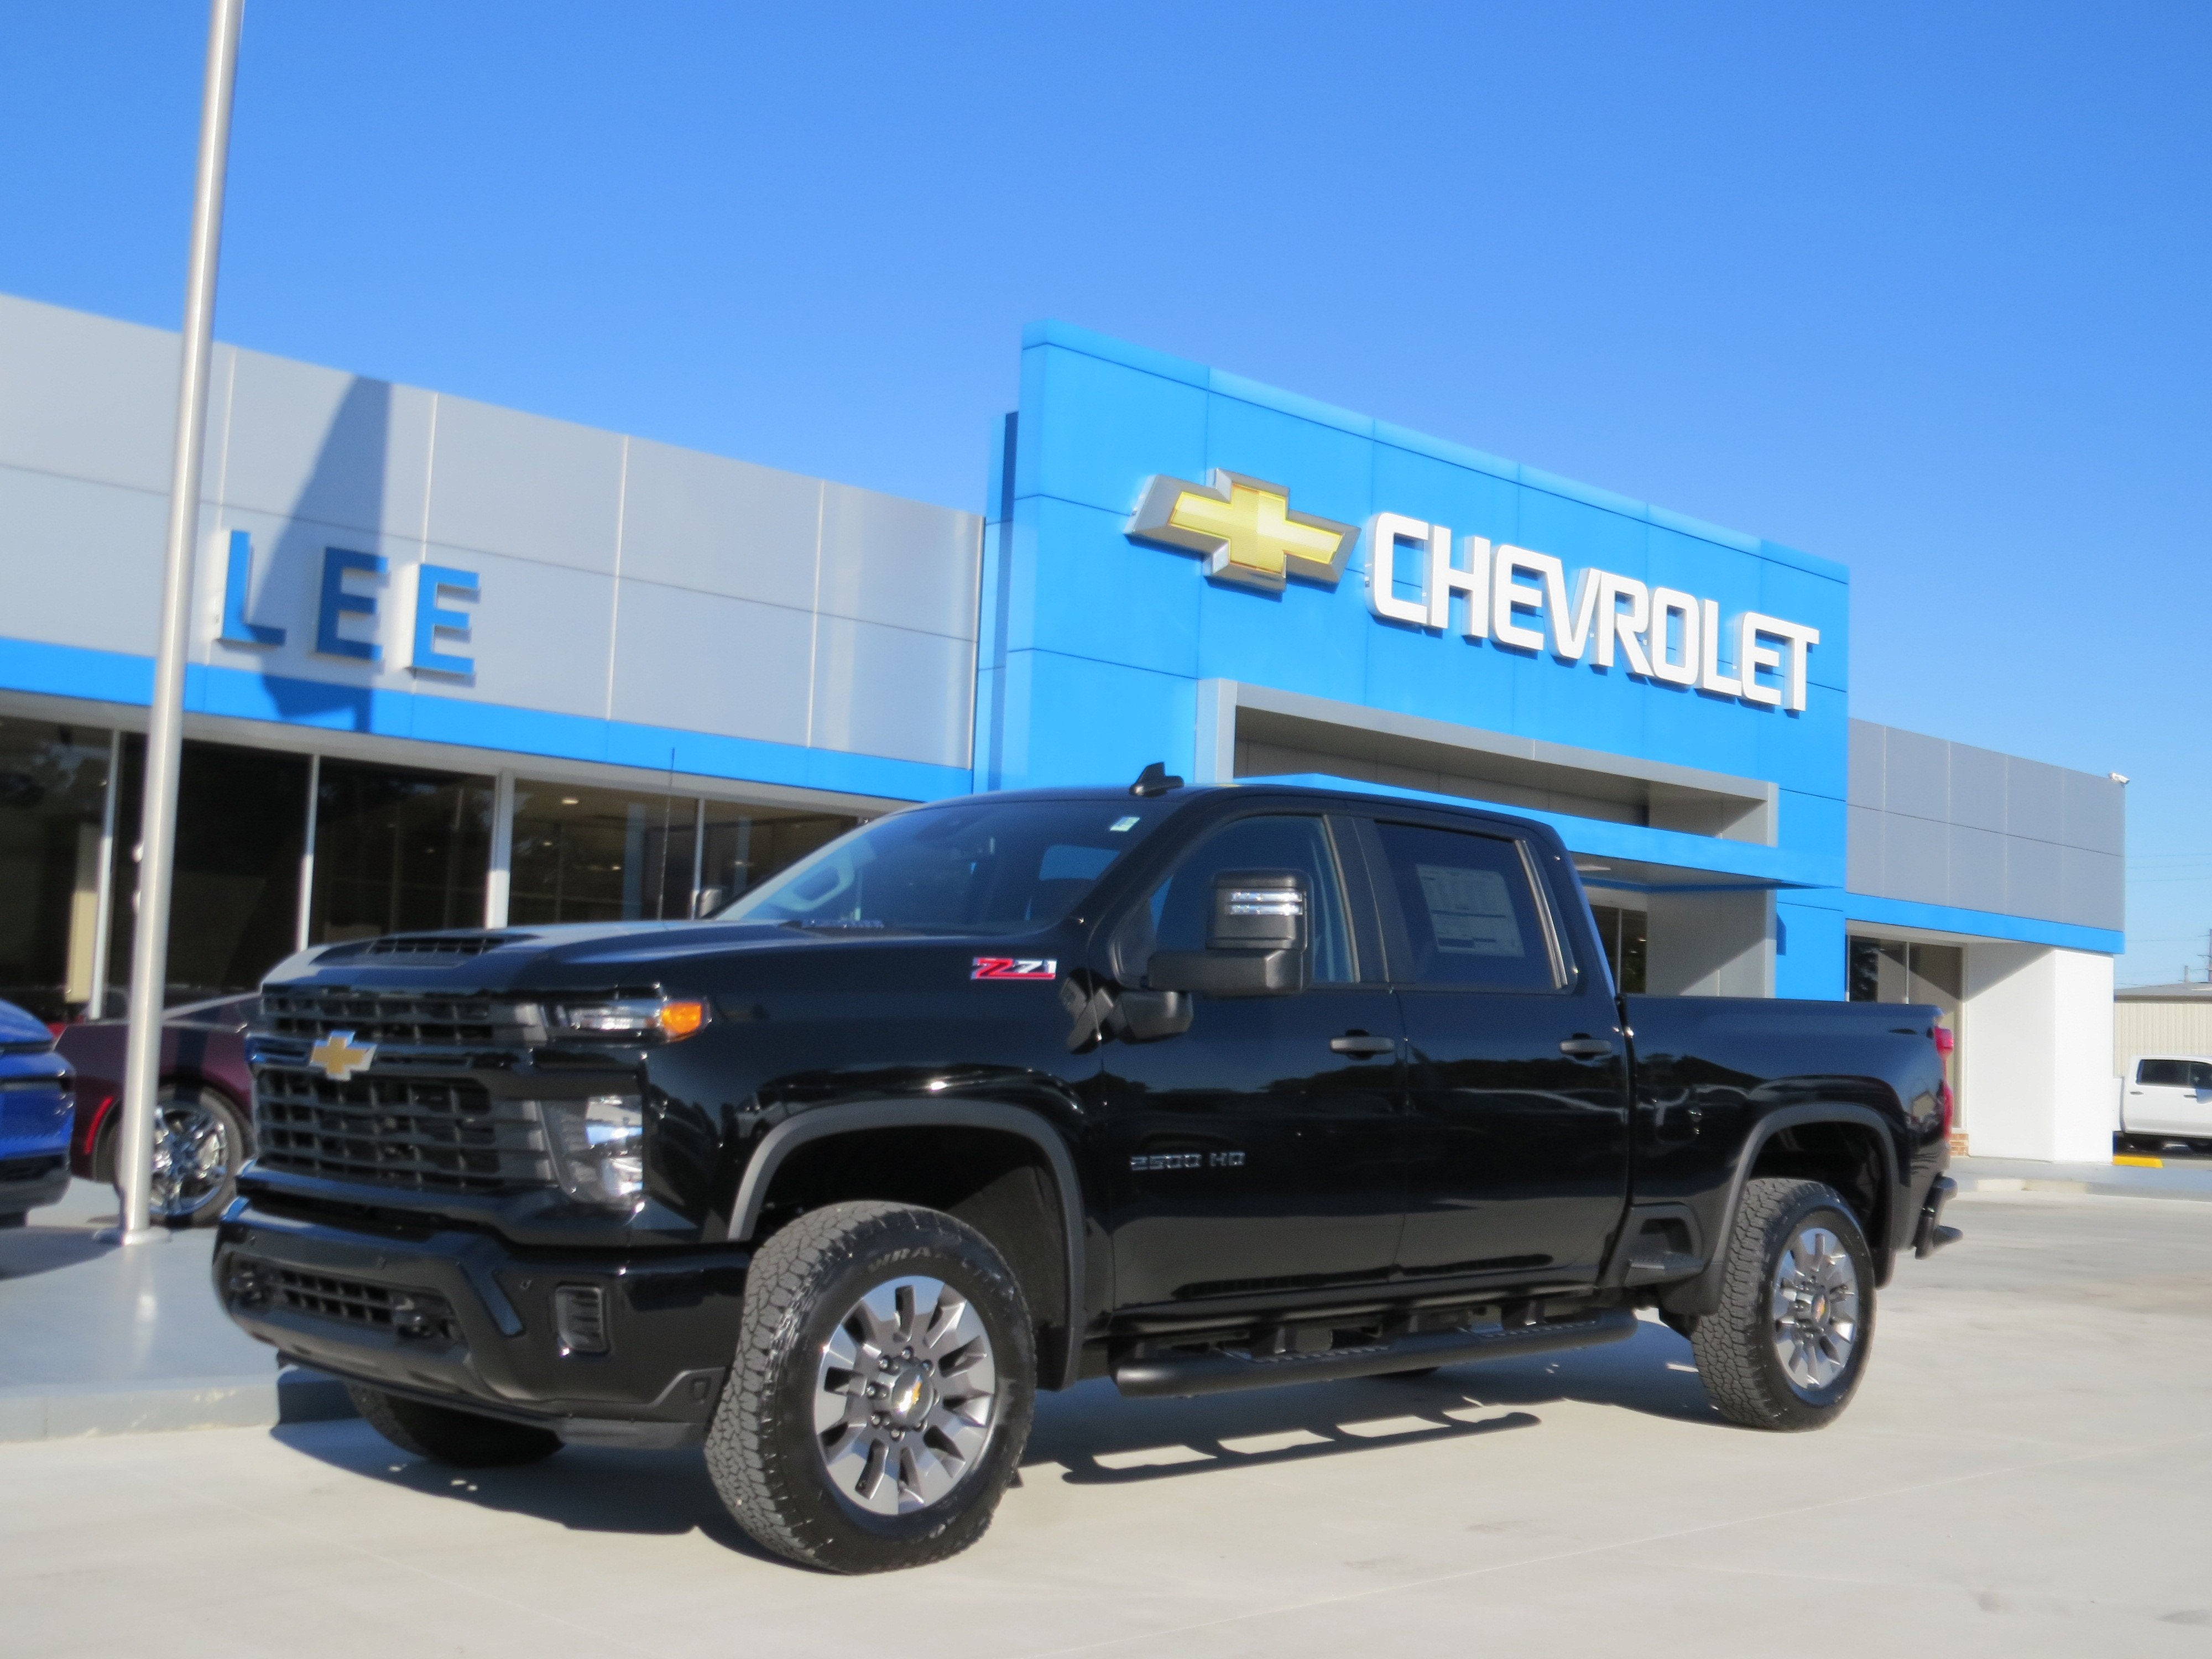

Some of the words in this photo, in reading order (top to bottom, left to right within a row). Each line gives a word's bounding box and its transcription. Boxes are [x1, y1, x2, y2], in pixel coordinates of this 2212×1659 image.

[219, 529, 480, 675] LEE
[1366, 512, 1819, 712] CHEVROLET
[971, 957, 1057, 979] Z71
[1130, 1154, 1202, 1171] 2500
[1210, 1151, 1245, 1167] HD
